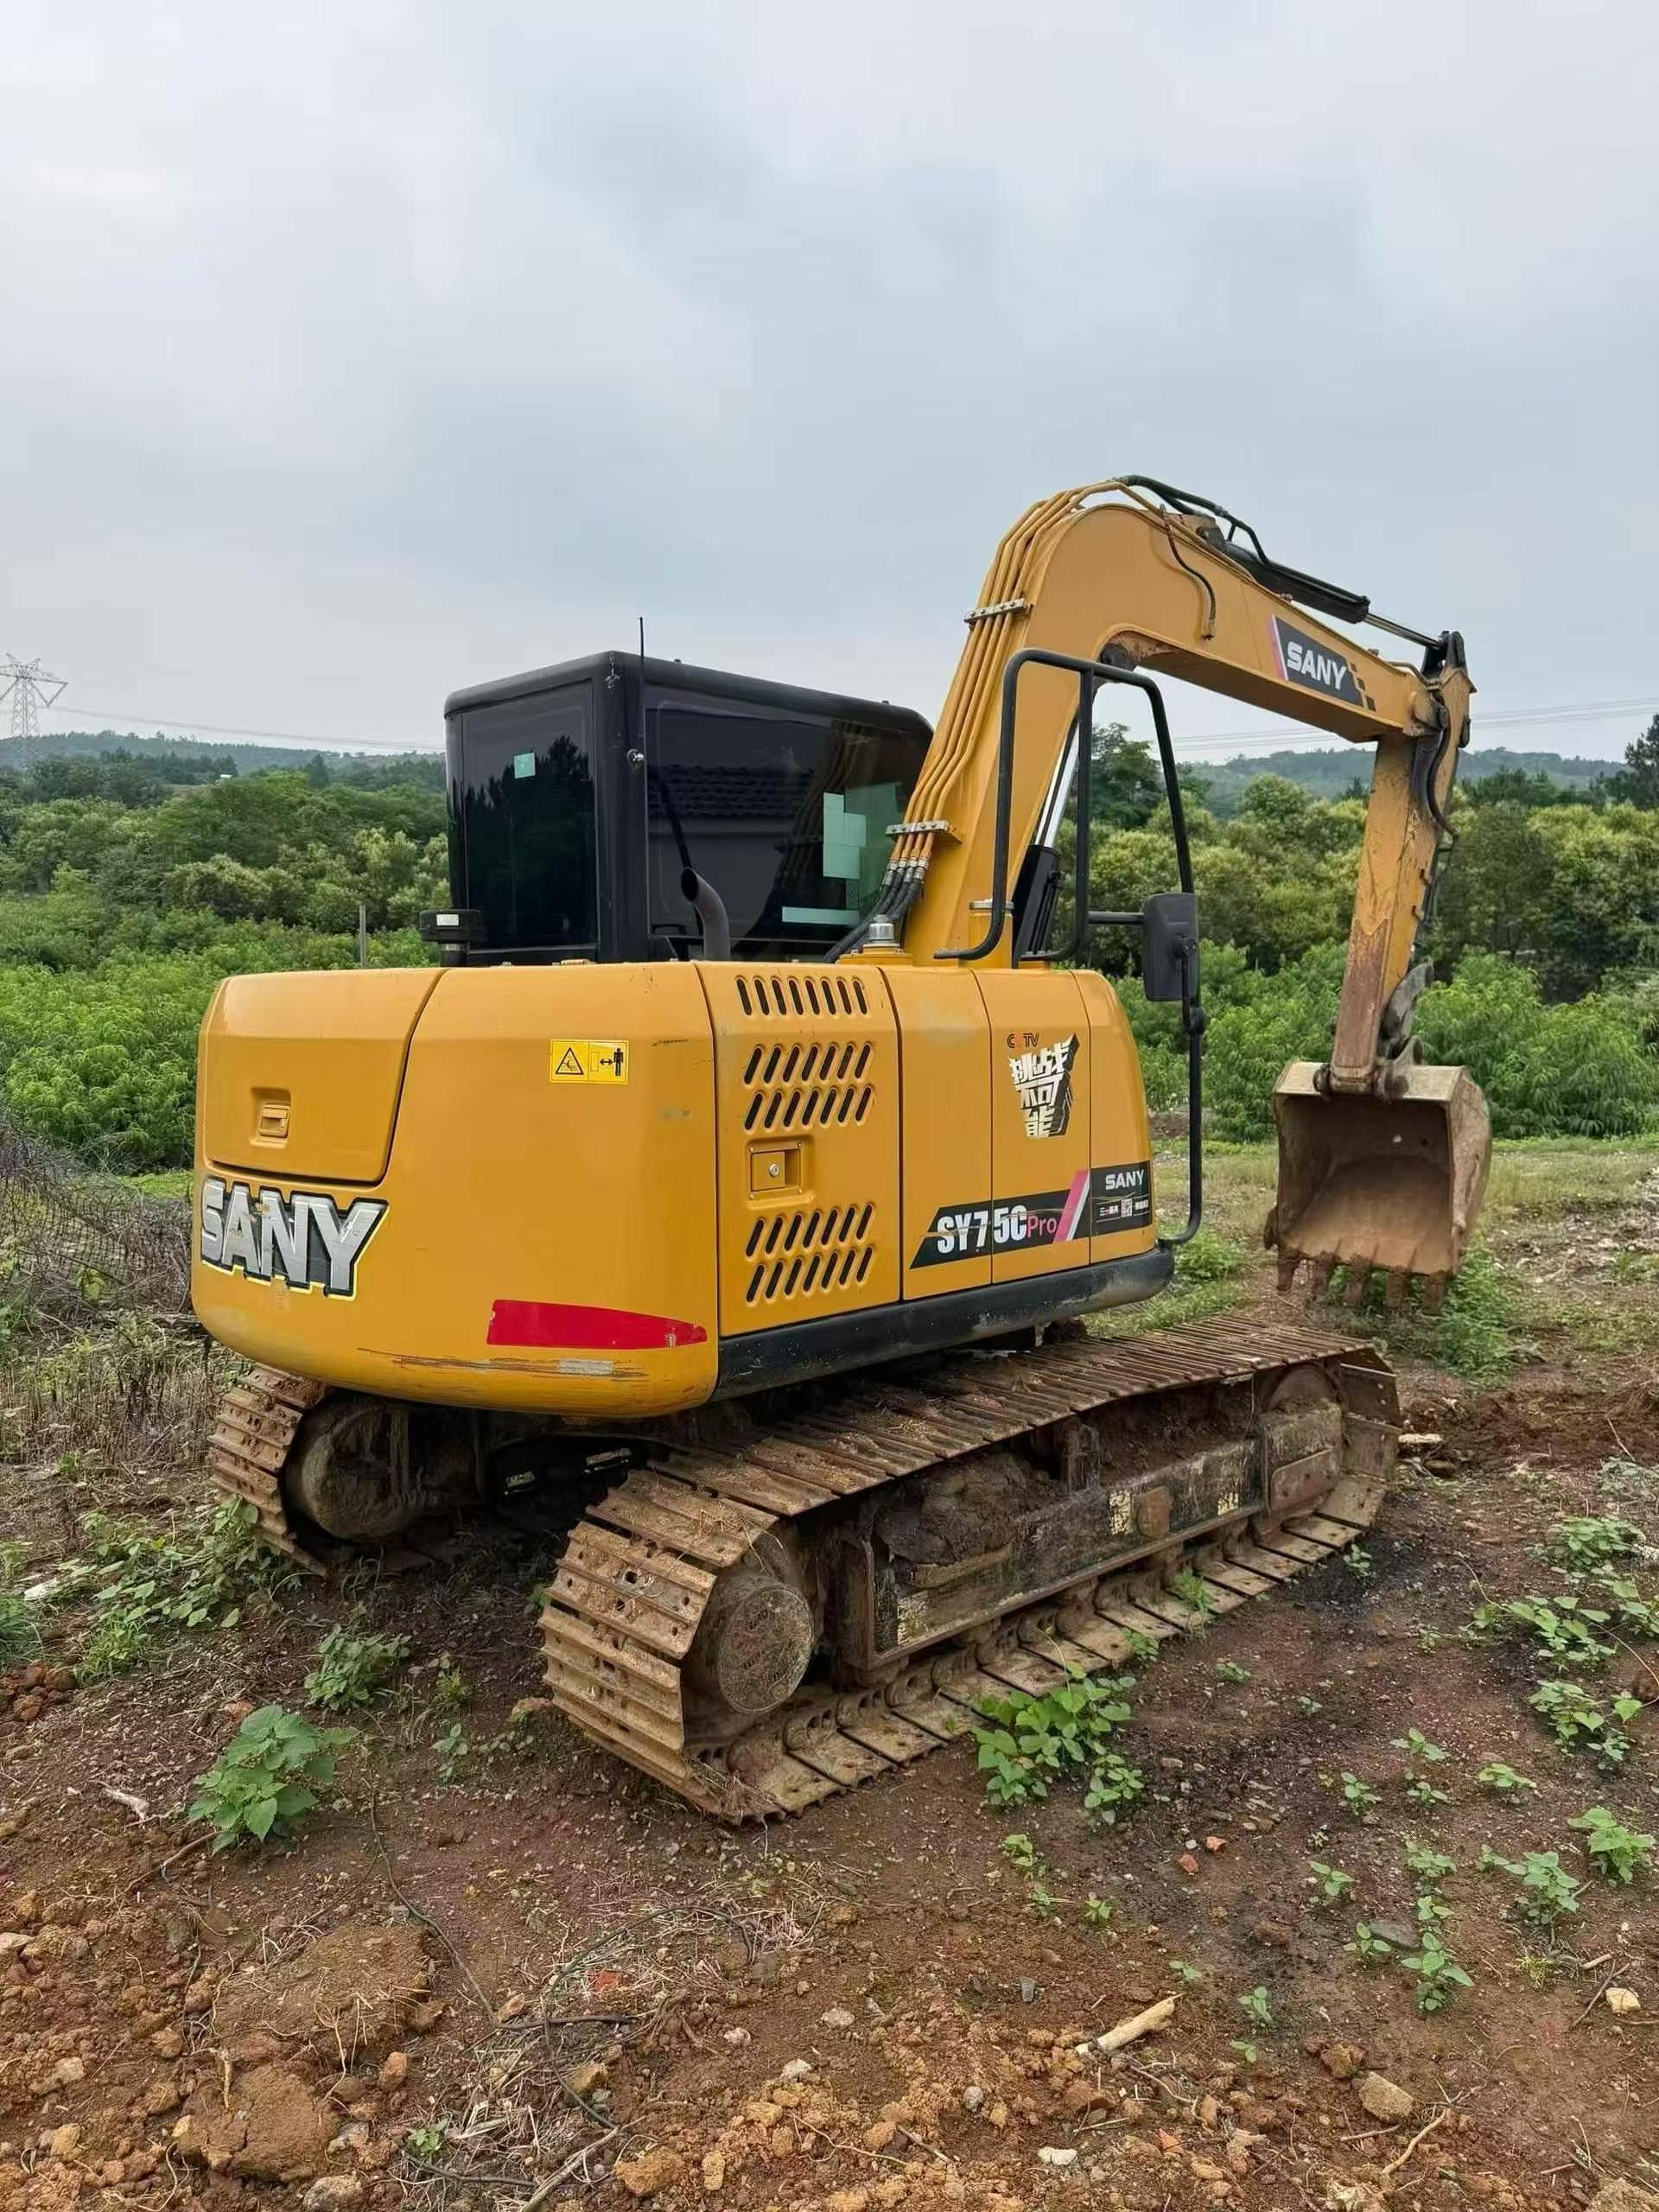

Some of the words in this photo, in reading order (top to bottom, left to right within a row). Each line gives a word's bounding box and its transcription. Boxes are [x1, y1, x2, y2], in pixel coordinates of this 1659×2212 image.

[1287, 641, 1347, 690] SANY
[1007, 1033, 1039, 1048] CTV
[1105, 1170, 1145, 1190] SANY
[201, 1176, 388, 1298] SANY
